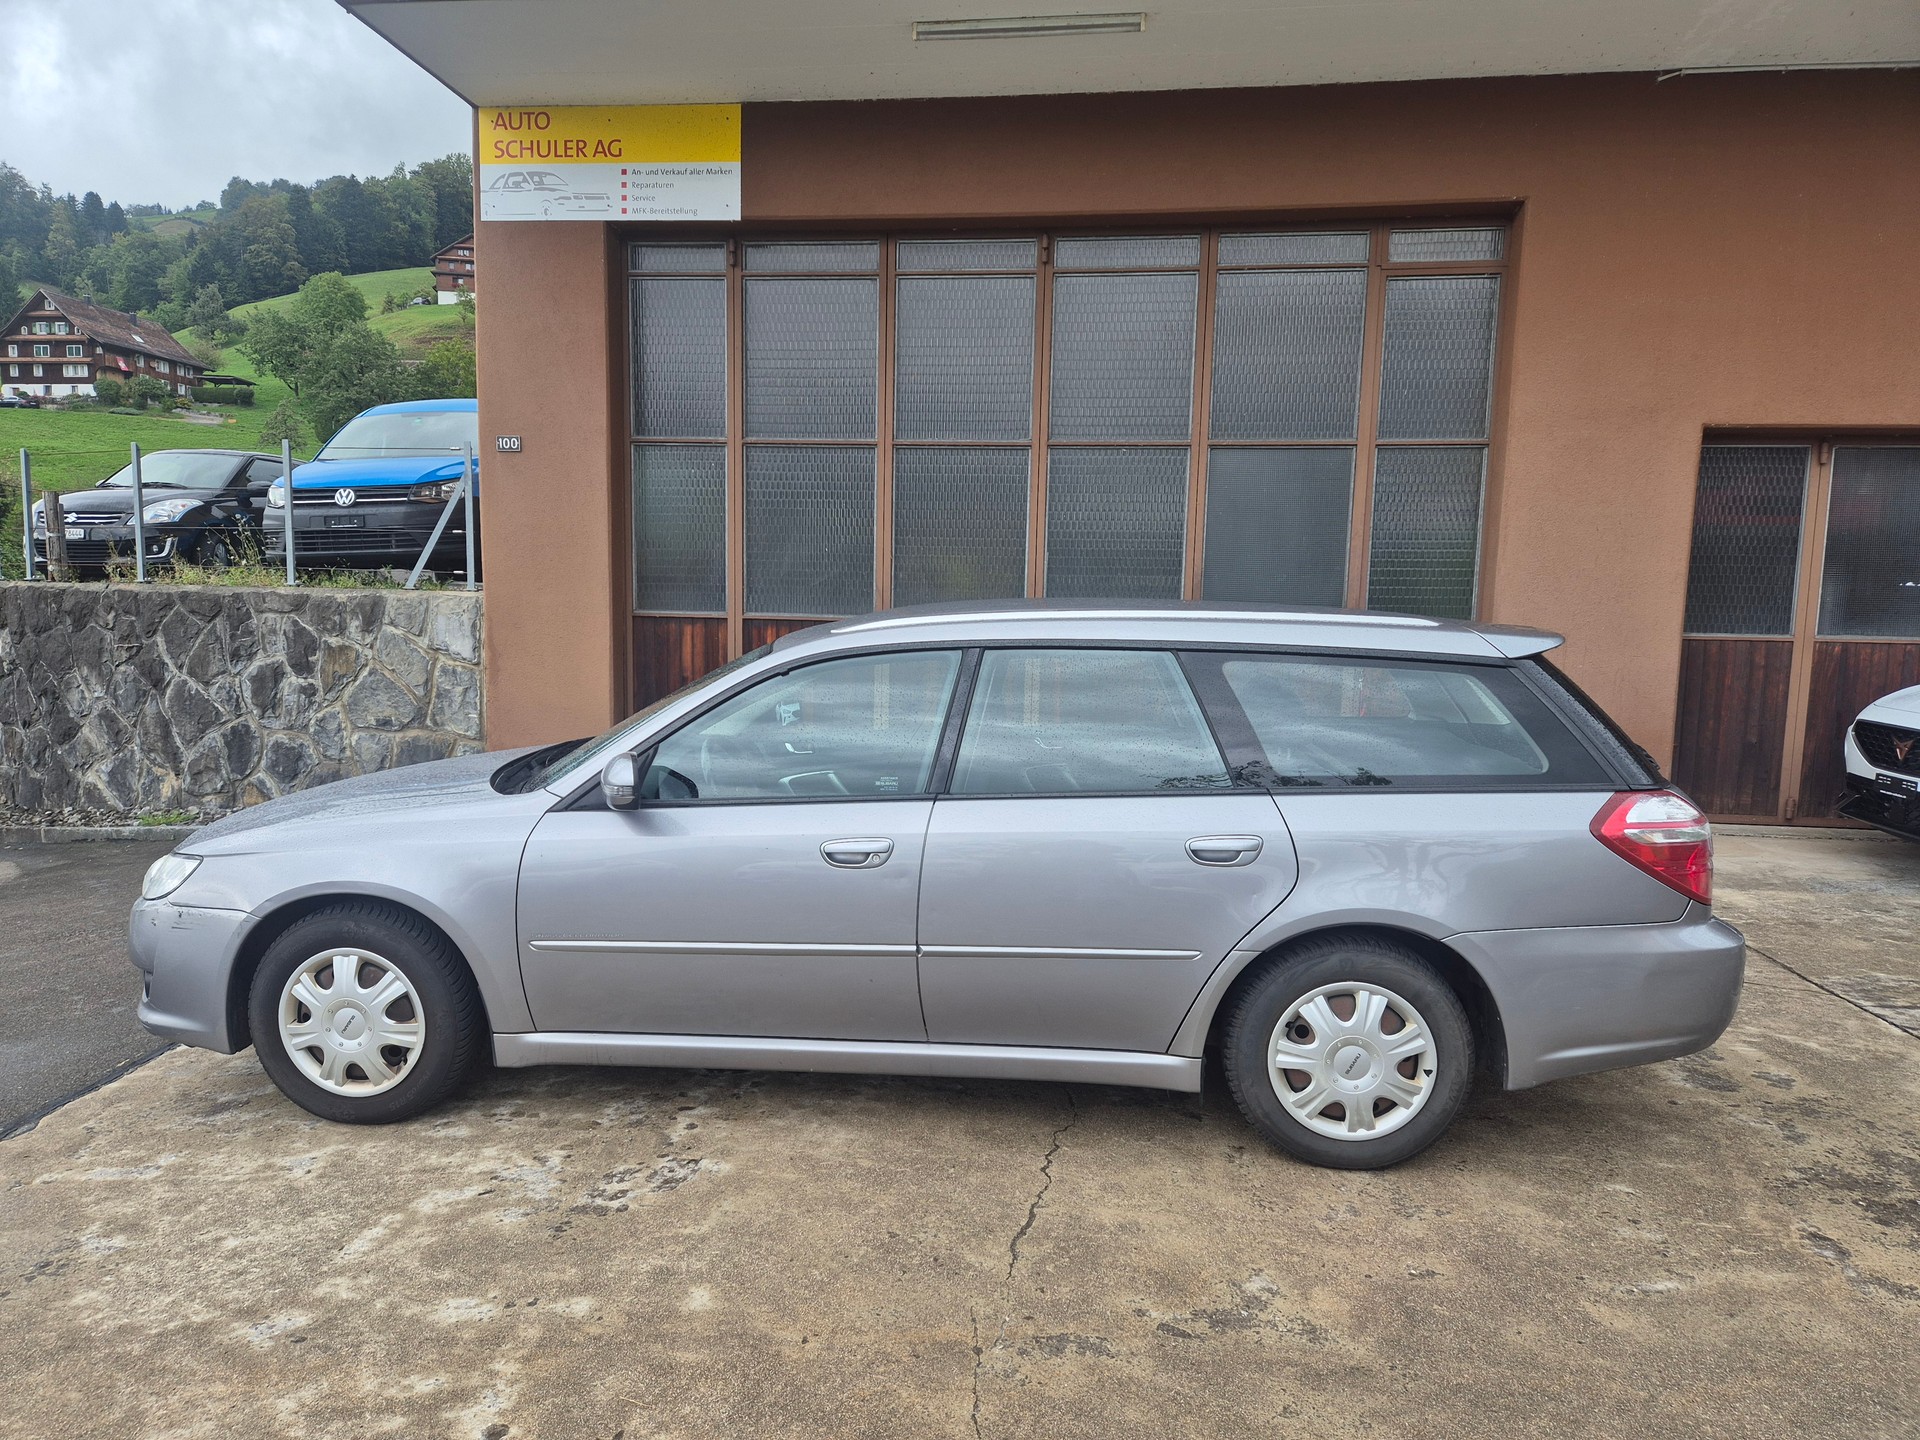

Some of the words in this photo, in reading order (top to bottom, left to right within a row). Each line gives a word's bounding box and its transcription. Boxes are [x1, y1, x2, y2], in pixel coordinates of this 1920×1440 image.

[493, 111, 551, 131] AUTO
[494, 139, 588, 159] SCHULER
[592, 139, 623, 158] AG
[645, 168, 659, 176] und
[660, 168, 688, 176] Verkauf
[705, 167, 733, 175] Marken
[631, 181, 675, 190] Reparaturen
[631, 194, 656, 202] Service
[631, 207, 698, 217] MFK-Bereitstellung
[498, 437, 518, 449] 100
[1345, 1052, 1362, 1075] SUBARU
